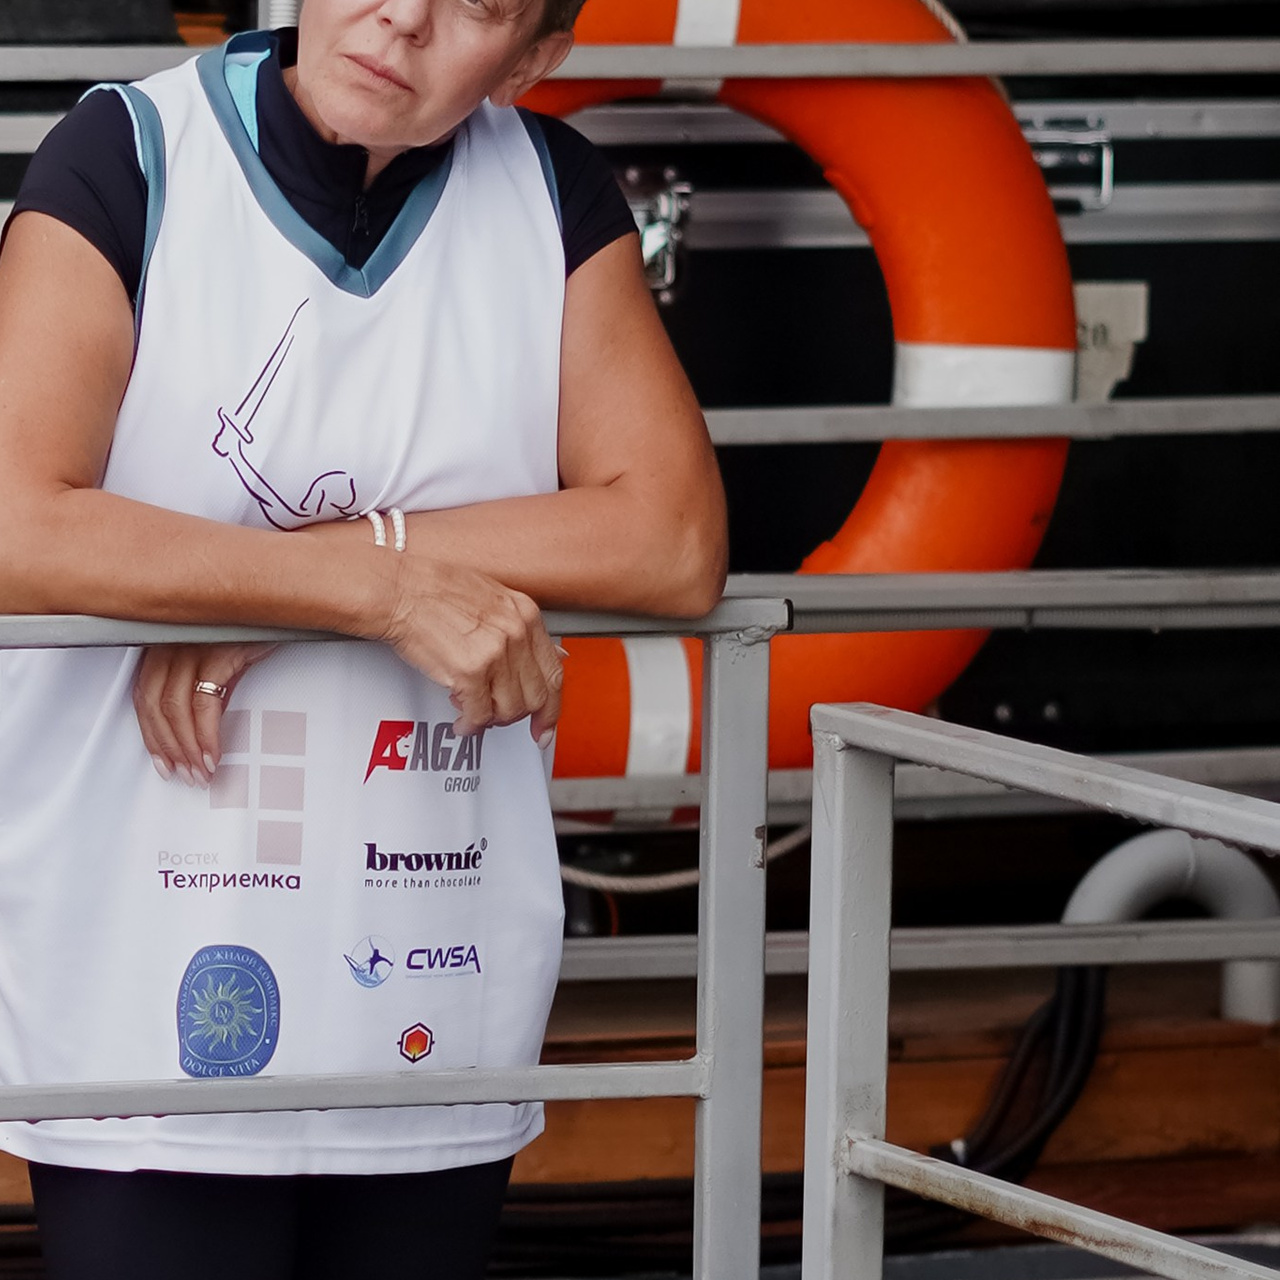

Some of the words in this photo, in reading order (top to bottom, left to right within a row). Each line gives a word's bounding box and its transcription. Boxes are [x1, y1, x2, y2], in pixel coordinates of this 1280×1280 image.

[158, 851, 219, 866] Ростех
[158, 870, 301, 893] Техприемка
[365, 879, 398, 888] more
[404, 877, 430, 889] than
[434, 875, 481, 889] chocolate
[406, 945, 481, 973] CWSA
[229, 1058, 261, 1076] VITA
